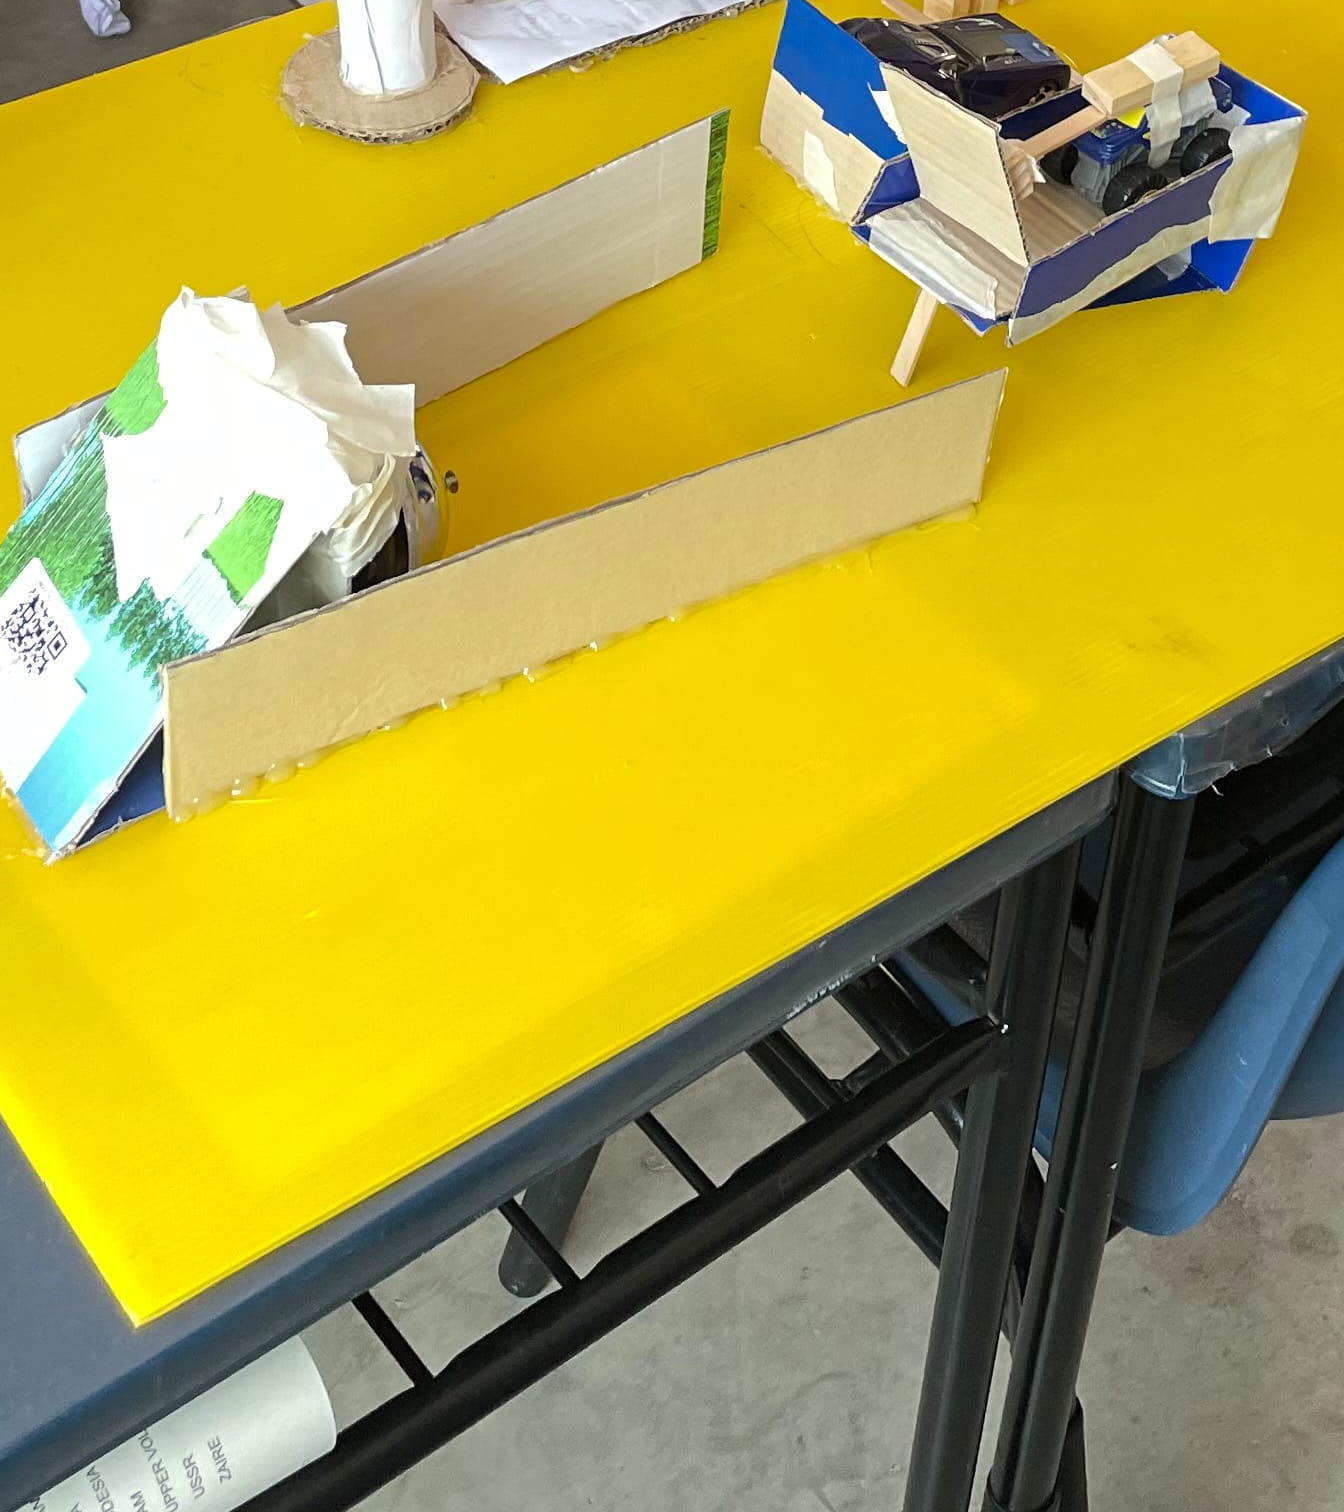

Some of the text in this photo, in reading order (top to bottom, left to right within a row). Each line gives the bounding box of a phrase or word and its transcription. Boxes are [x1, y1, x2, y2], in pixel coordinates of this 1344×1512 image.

[182, 1452, 205, 1500] USSR
[207, 1435, 232, 1484] ZAIRE
[152, 1459, 178, 1512] UPPER
